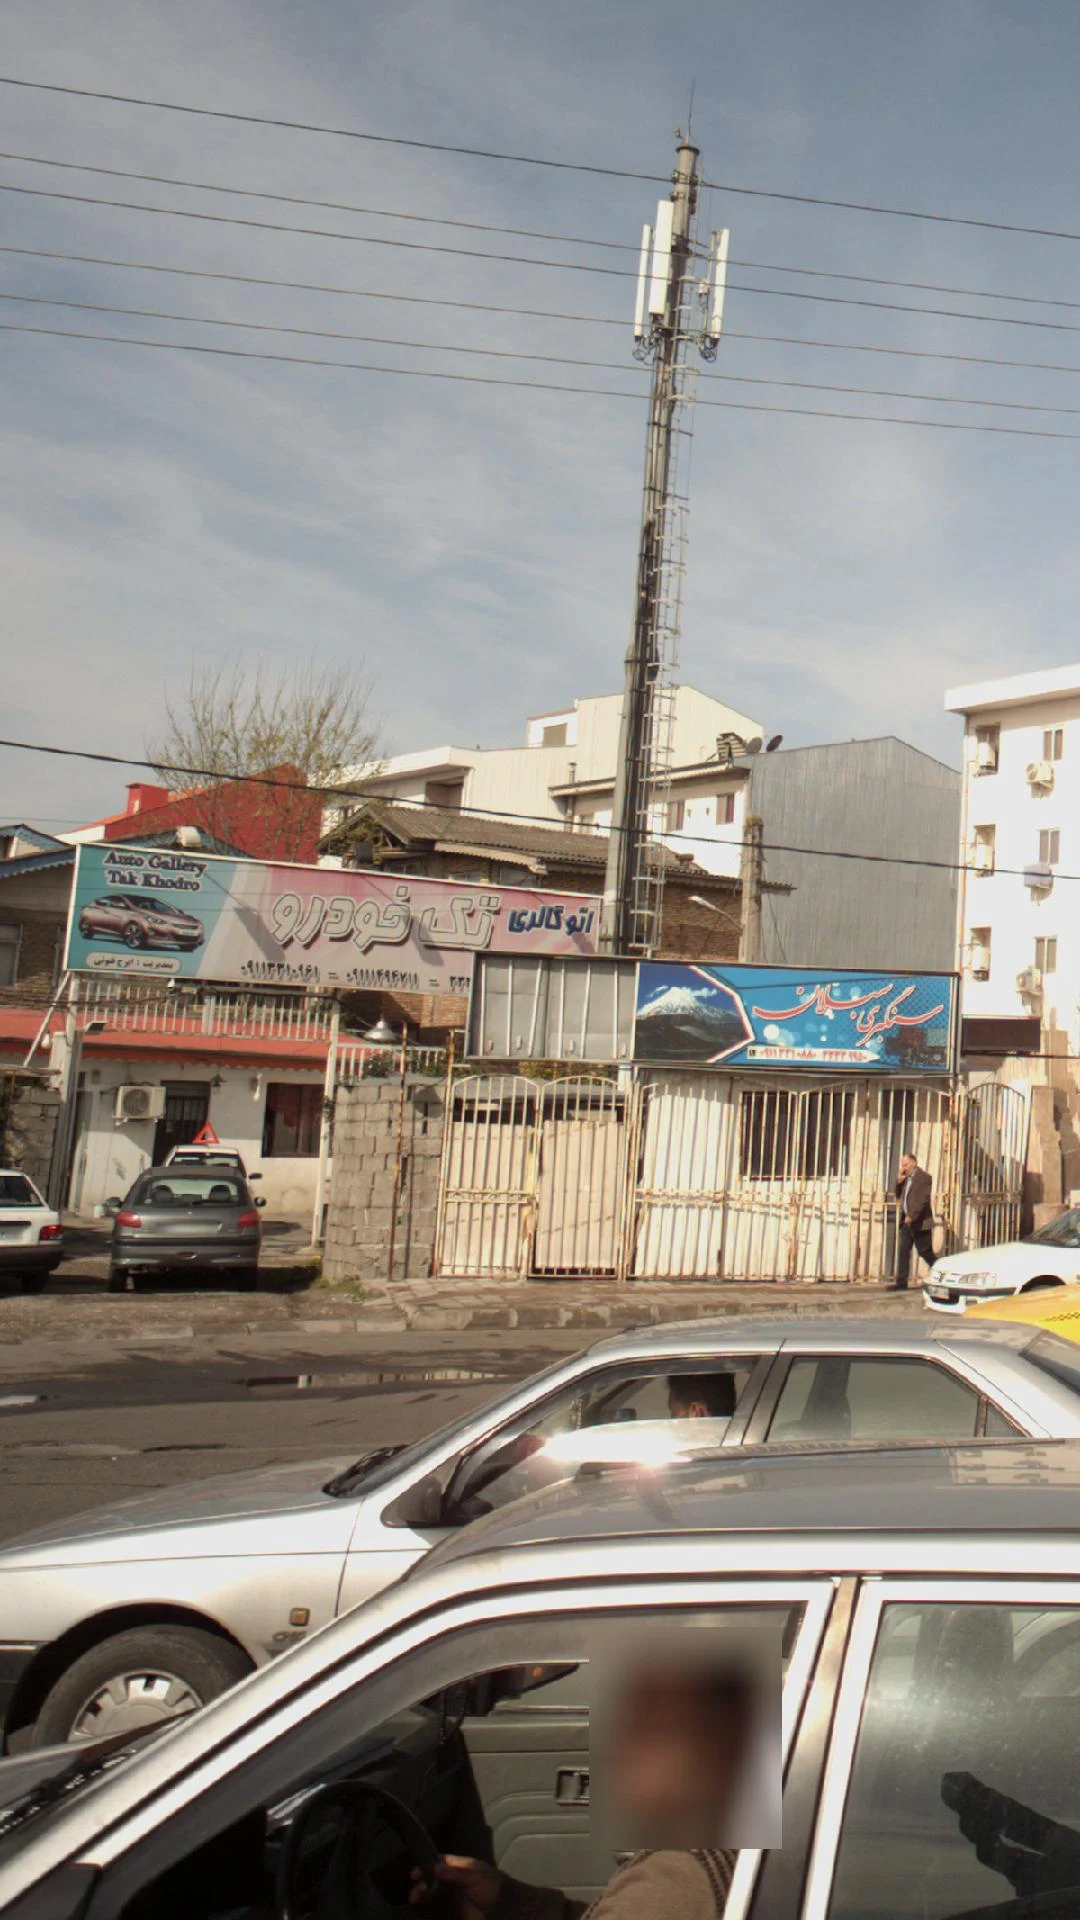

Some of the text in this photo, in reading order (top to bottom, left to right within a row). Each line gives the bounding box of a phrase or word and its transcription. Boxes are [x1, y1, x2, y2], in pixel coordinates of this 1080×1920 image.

[104, 850, 206, 877] Auto Gallery
[107, 870, 200, 891] Tak Khodro
[271, 885, 594, 952] اتو گالری تک خودرو
